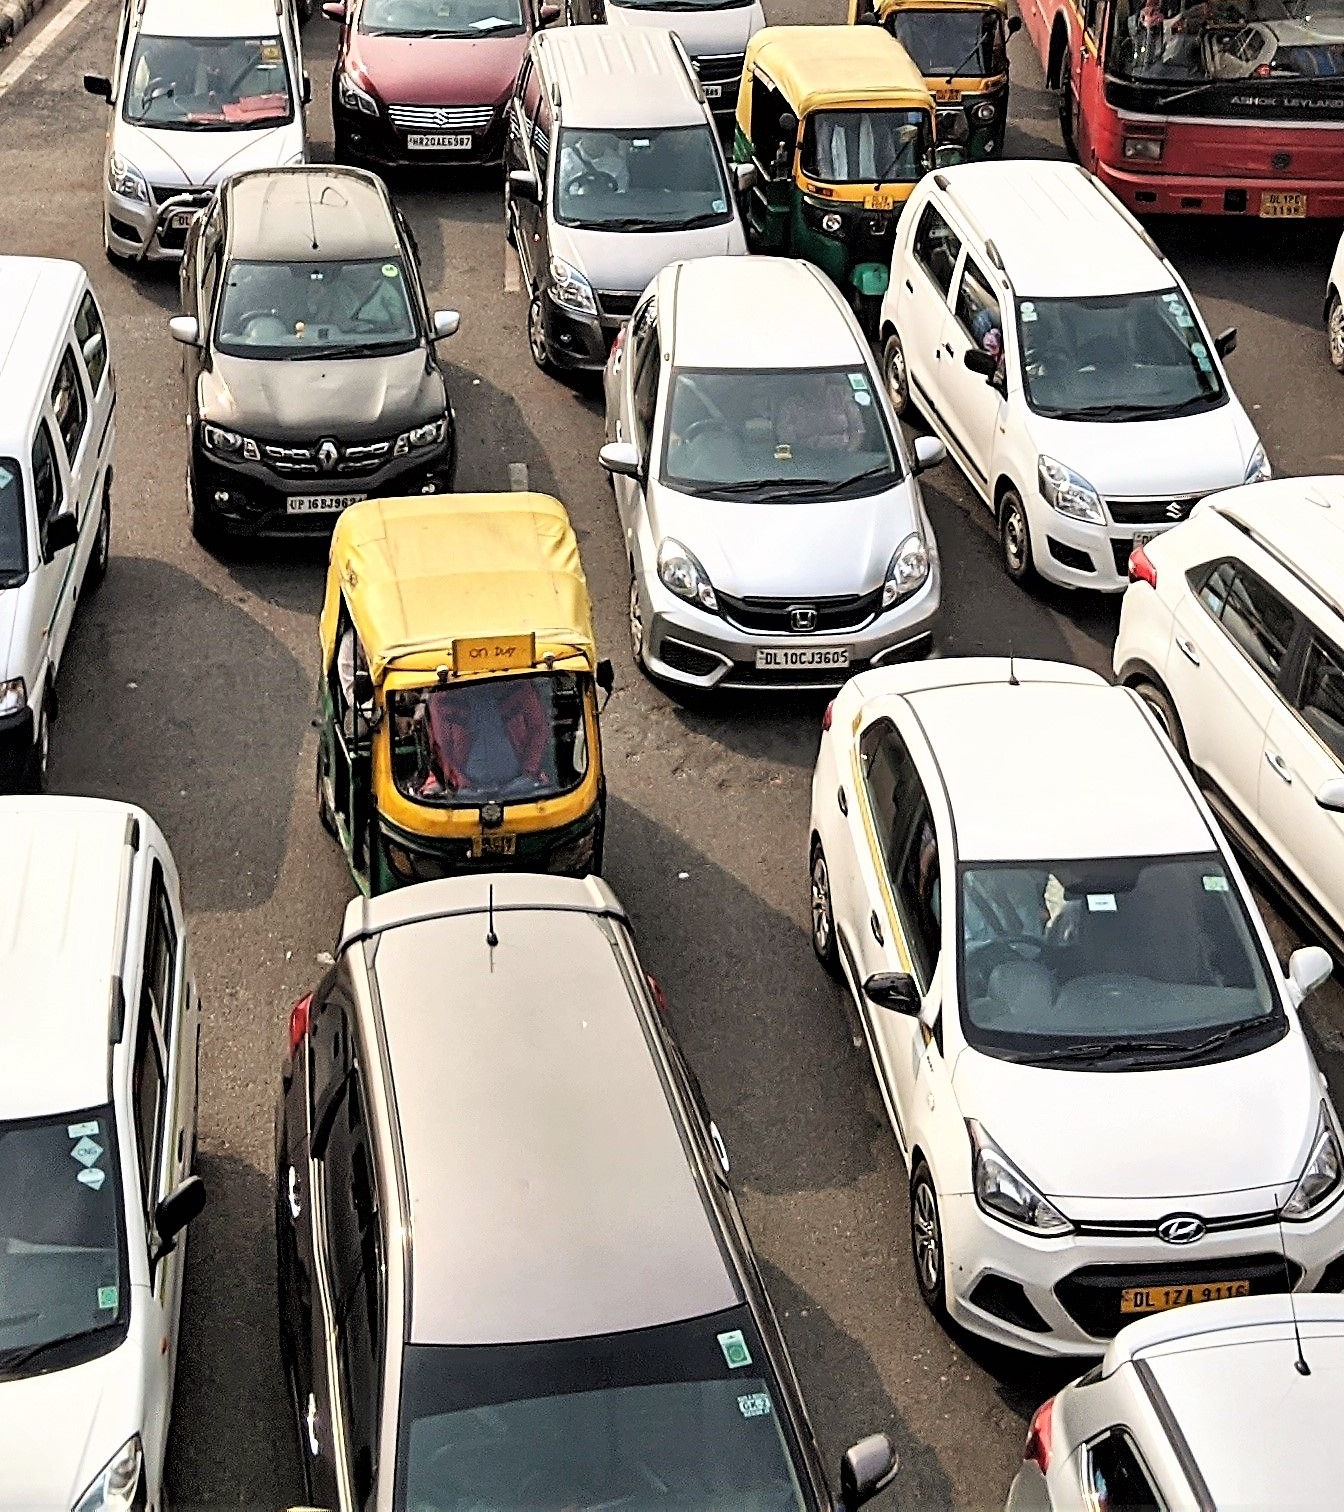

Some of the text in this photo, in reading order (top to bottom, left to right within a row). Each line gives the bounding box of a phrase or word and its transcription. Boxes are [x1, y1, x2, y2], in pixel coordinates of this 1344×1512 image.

[1230, 95, 1344, 109] ASHOK LEYLAND
[764, 650, 848, 666] DL10CJ3605
[1133, 1291, 1155, 1307] DL
